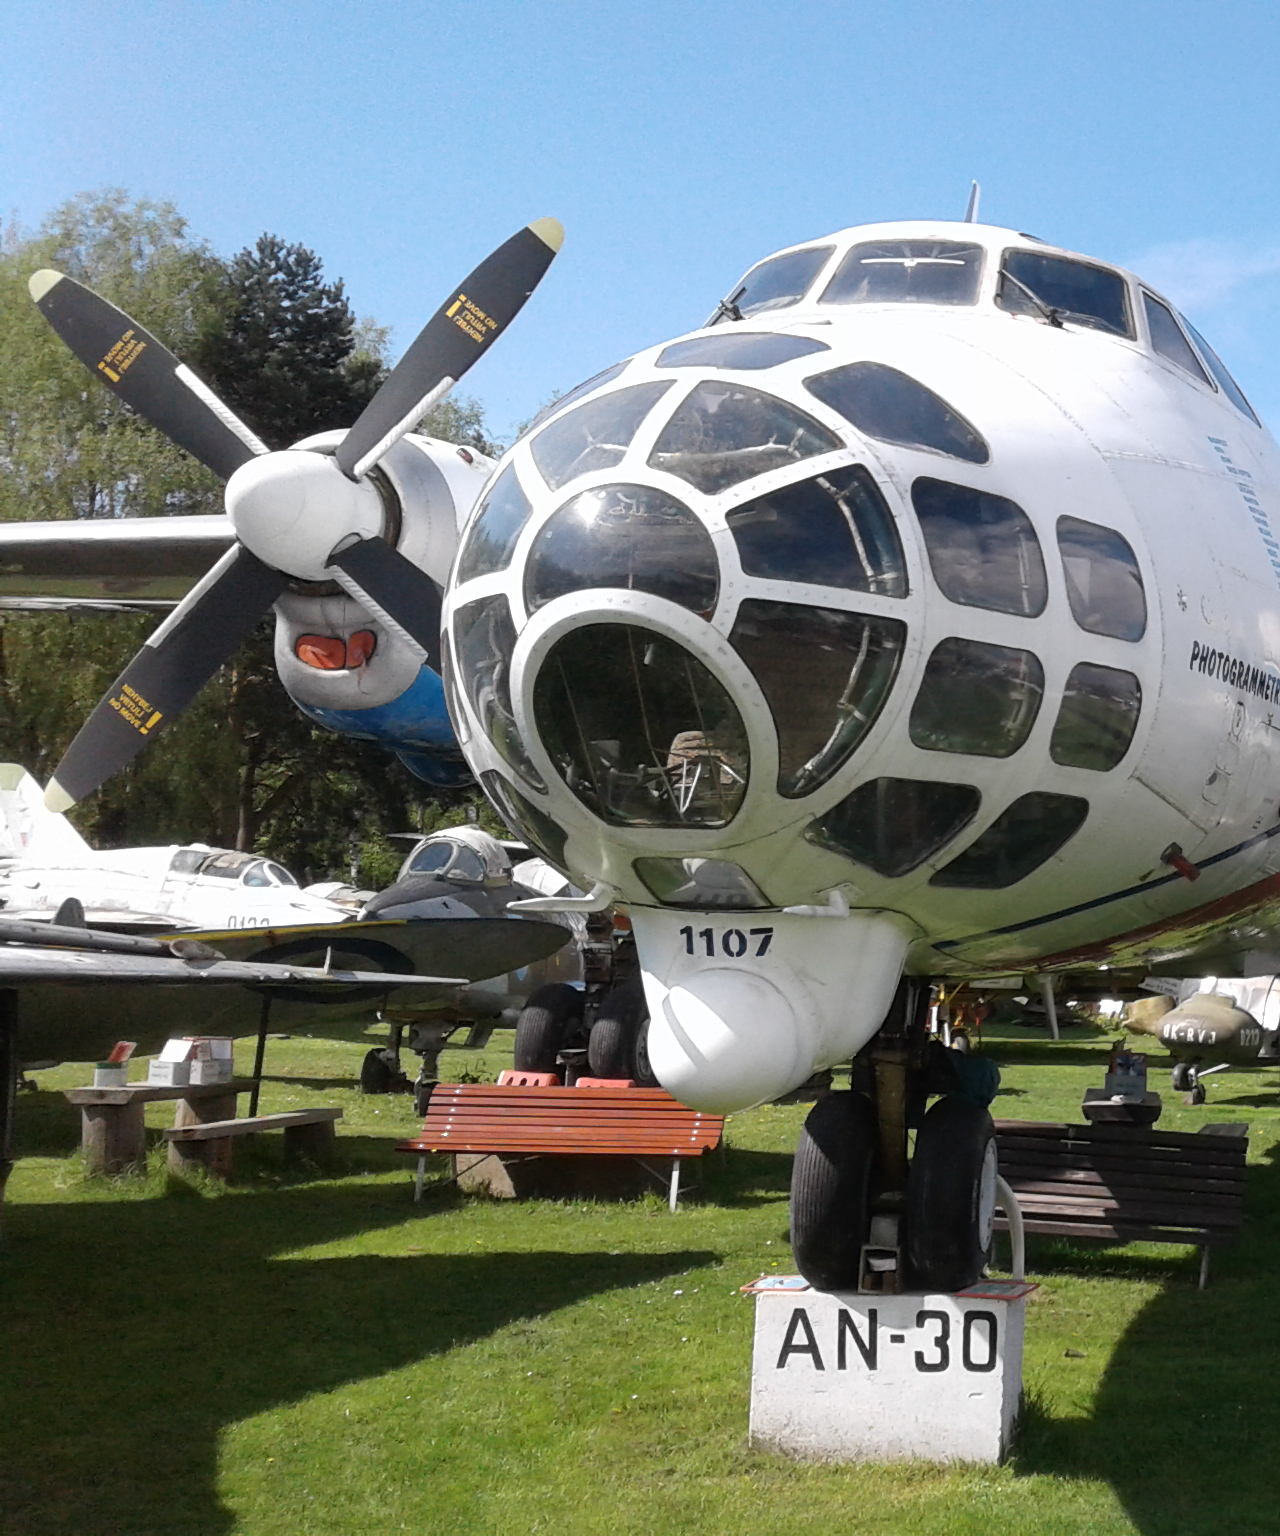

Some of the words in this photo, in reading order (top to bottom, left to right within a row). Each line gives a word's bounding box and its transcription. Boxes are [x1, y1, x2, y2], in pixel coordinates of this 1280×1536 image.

[464, 299, 486, 320] MOVE
[484, 317, 497, 329] NO
[121, 329, 134, 341] NO
[103, 340, 124, 362] MOVE
[108, 697, 121, 709] NO
[118, 706, 141, 728] MOVE
[680, 925, 774, 958] 1107
[776, 1307, 998, 1373] AN-30
